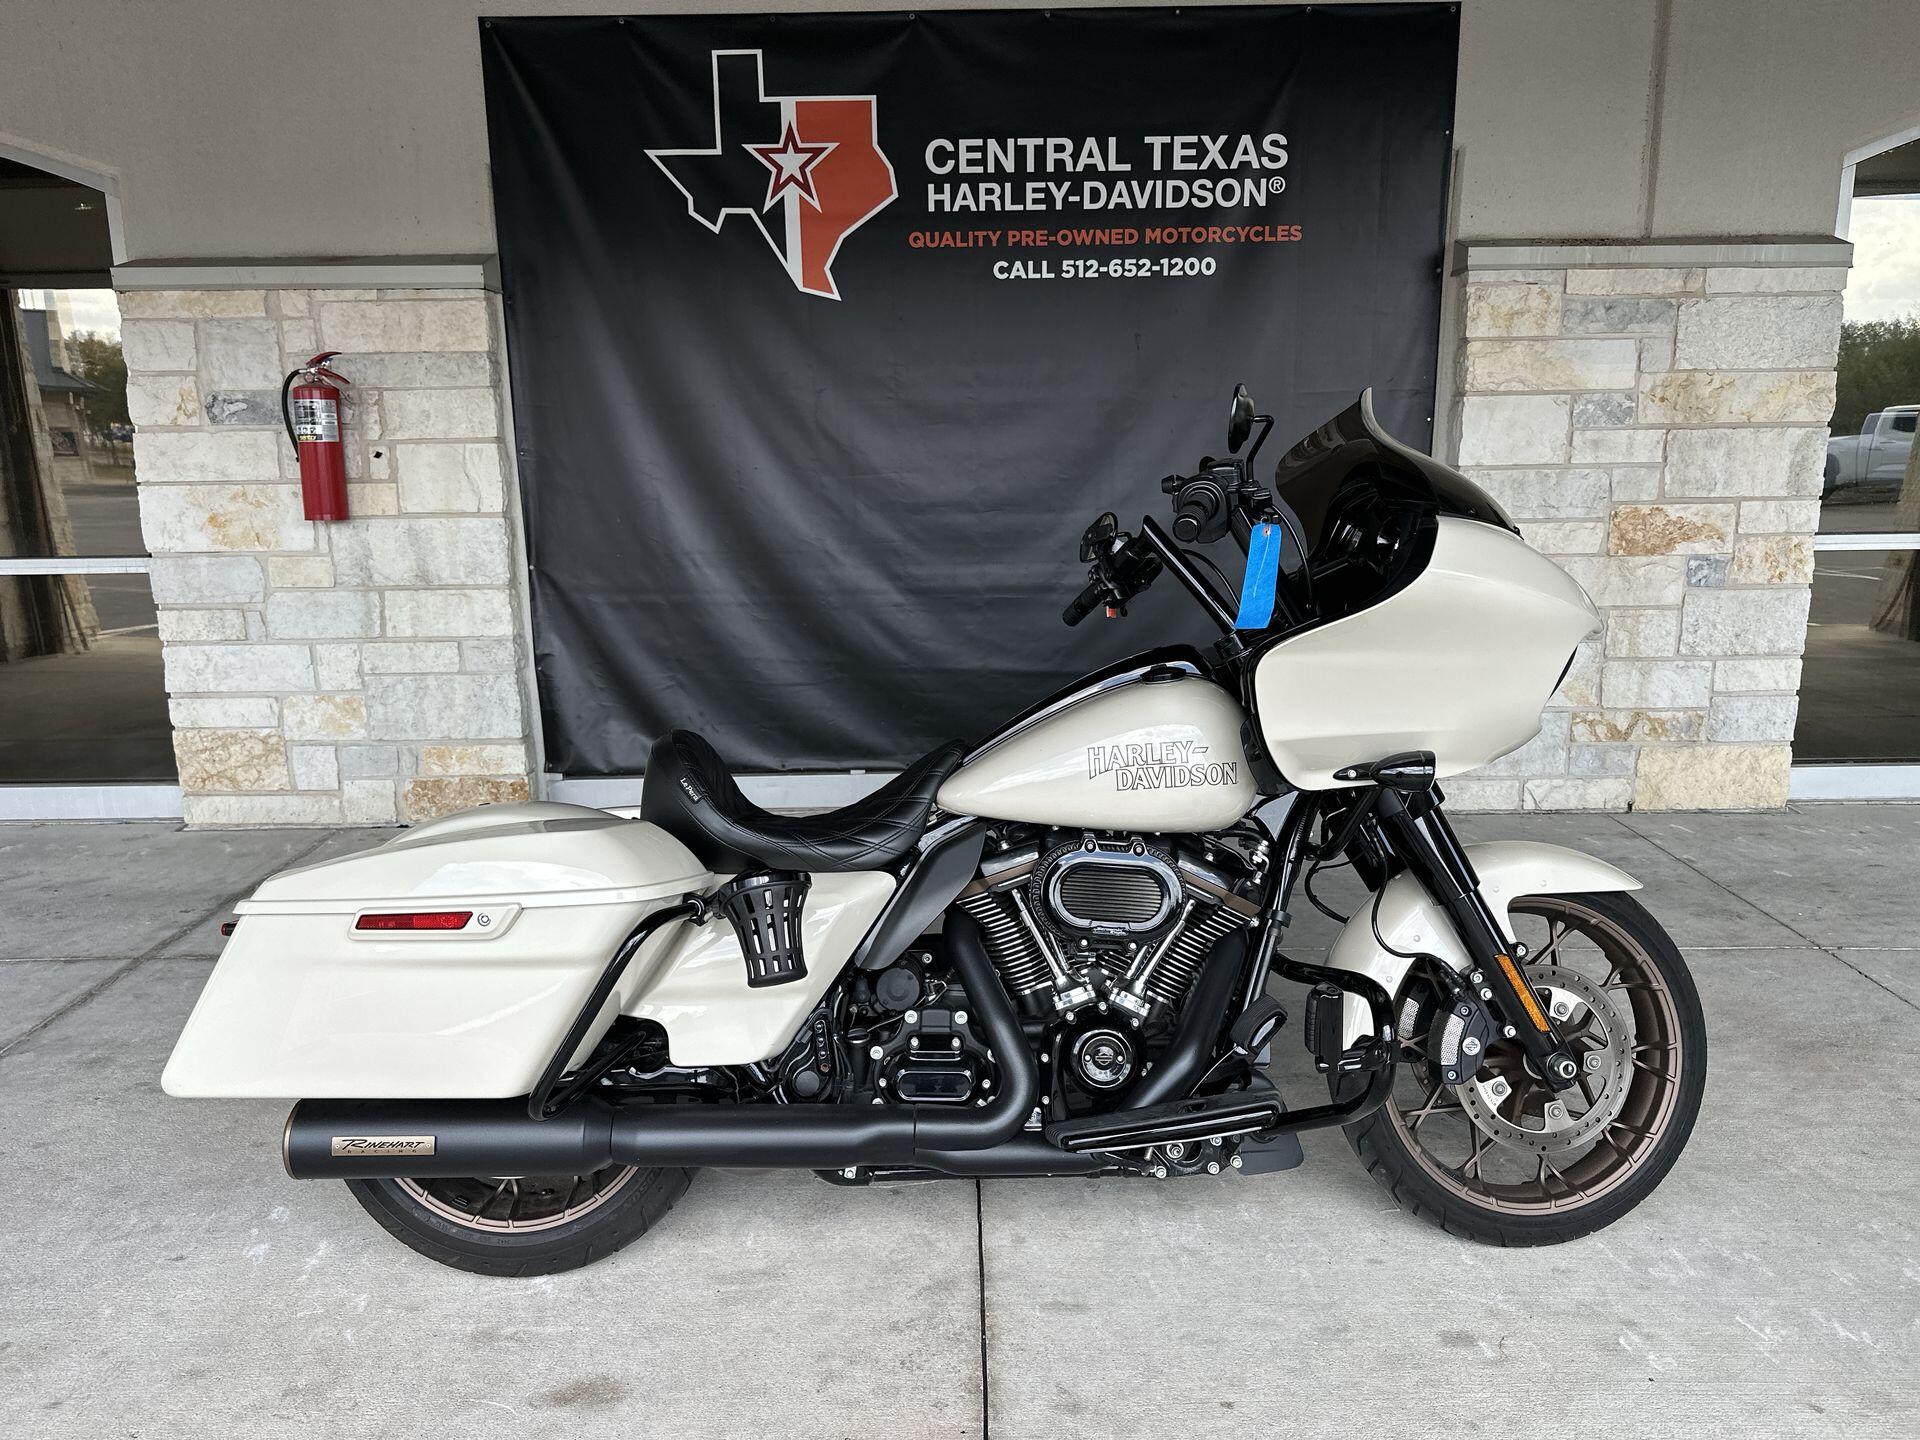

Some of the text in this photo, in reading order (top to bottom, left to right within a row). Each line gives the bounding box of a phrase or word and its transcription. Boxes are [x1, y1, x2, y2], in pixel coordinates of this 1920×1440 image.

[924, 133, 1288, 174] CENTRAL TEXAS
[908, 225, 1302, 248] QUALITY PRE-OWNED MOTORCYCLES
[993, 257, 1217, 280] CALL 512-652-1200
[1115, 762, 1238, 791] DAVIDSON
